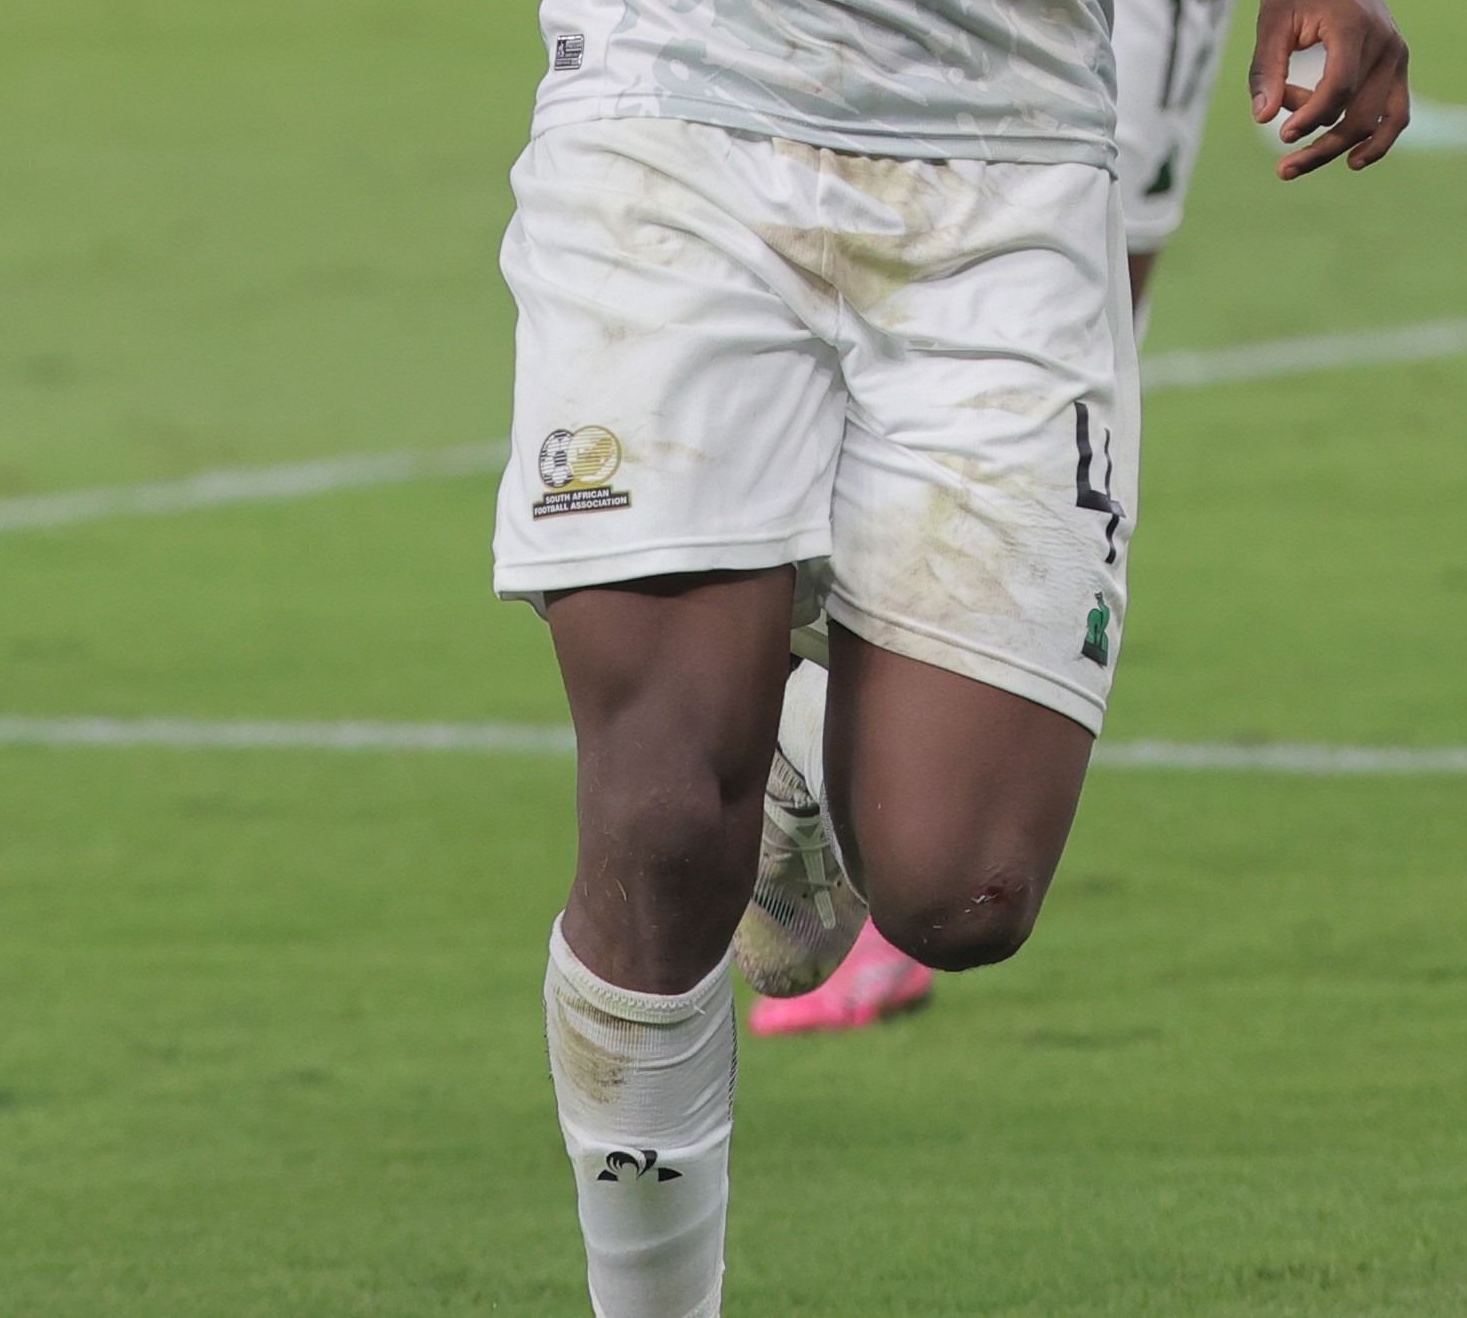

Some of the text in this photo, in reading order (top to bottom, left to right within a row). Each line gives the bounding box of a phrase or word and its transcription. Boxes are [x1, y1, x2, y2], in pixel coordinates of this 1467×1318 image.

[1073, 400, 1127, 565] 4
[534, 496, 627, 516] FOOTBALL ASSOCIATION
[545, 489, 609, 504] SOUTH AFRICAN
